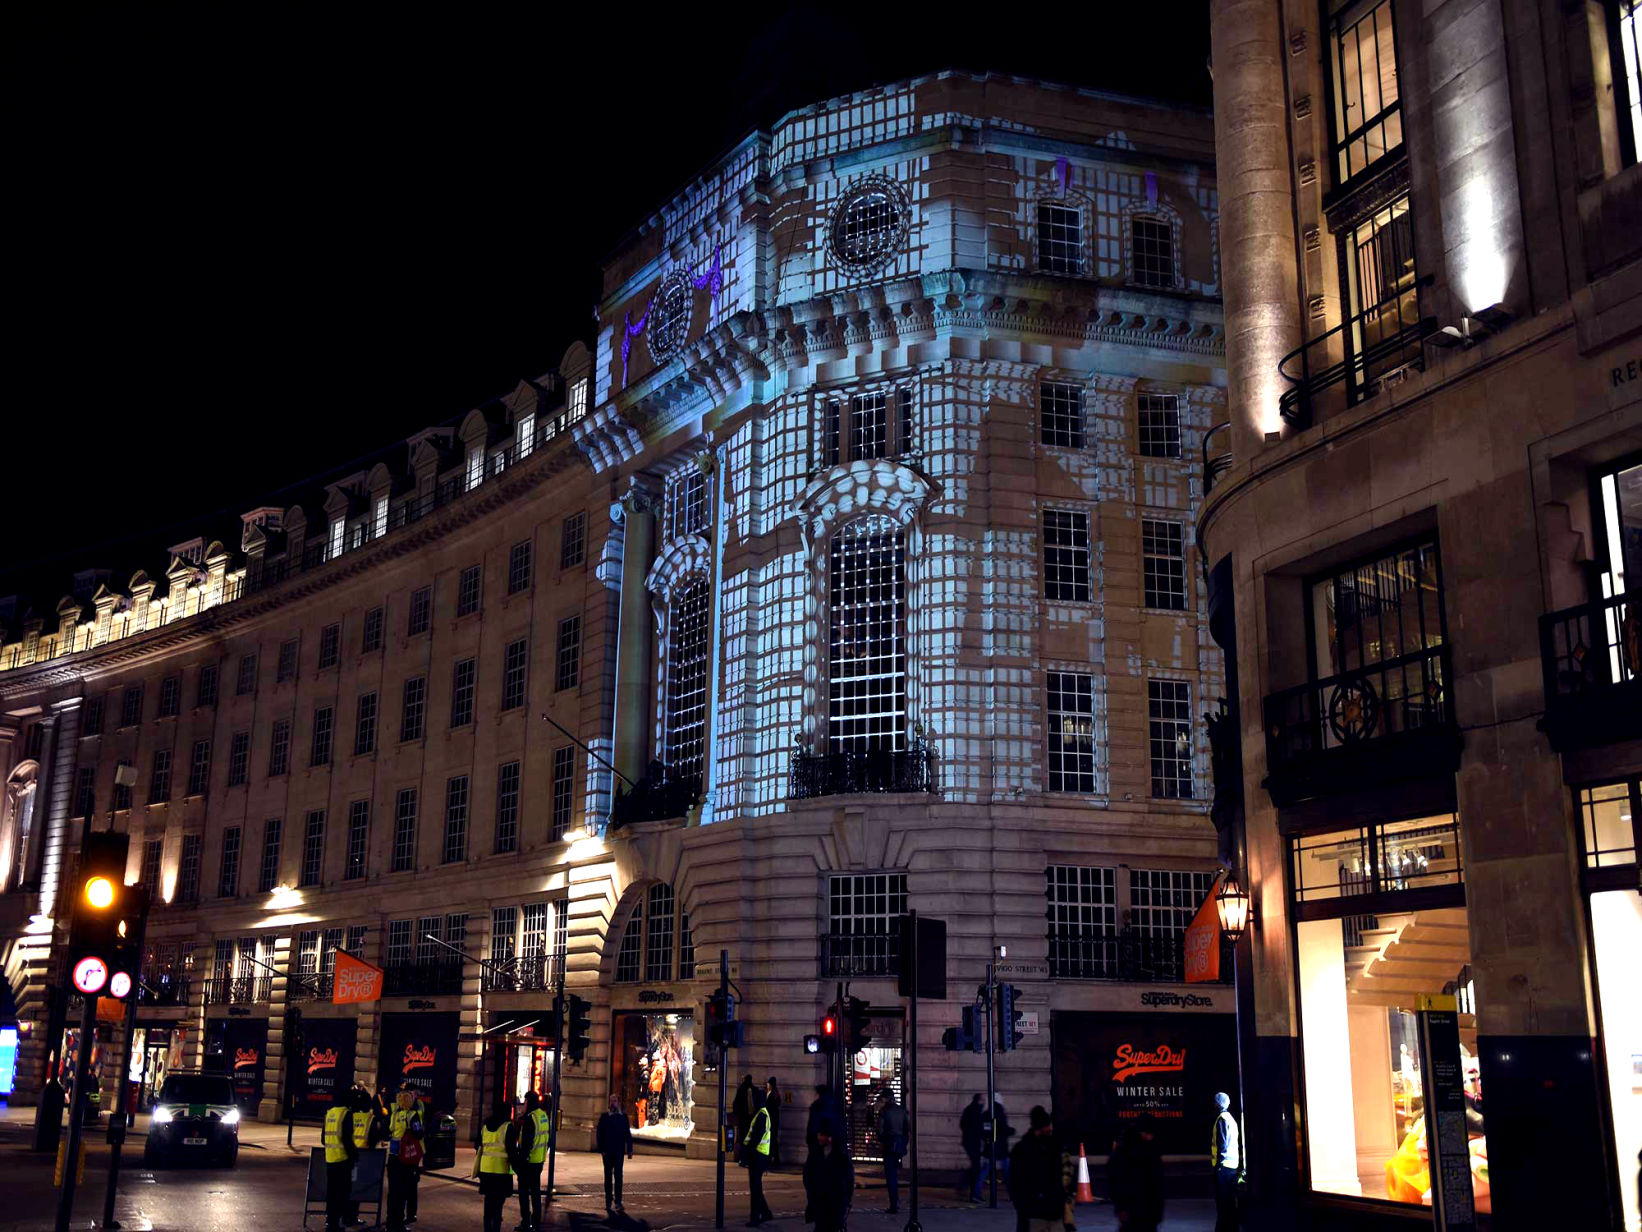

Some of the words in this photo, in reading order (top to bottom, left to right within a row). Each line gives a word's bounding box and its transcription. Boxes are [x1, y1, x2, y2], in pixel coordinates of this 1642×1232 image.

[1612, 359, 1642, 388] RE
[997, 965, 1013, 973] VIGO
[1015, 965, 1038, 974] STREET
[421, 1078, 433, 1088] SALE
[1116, 1086, 1156, 1097] WINTER
[1158, 1086, 1185, 1097] SALE
